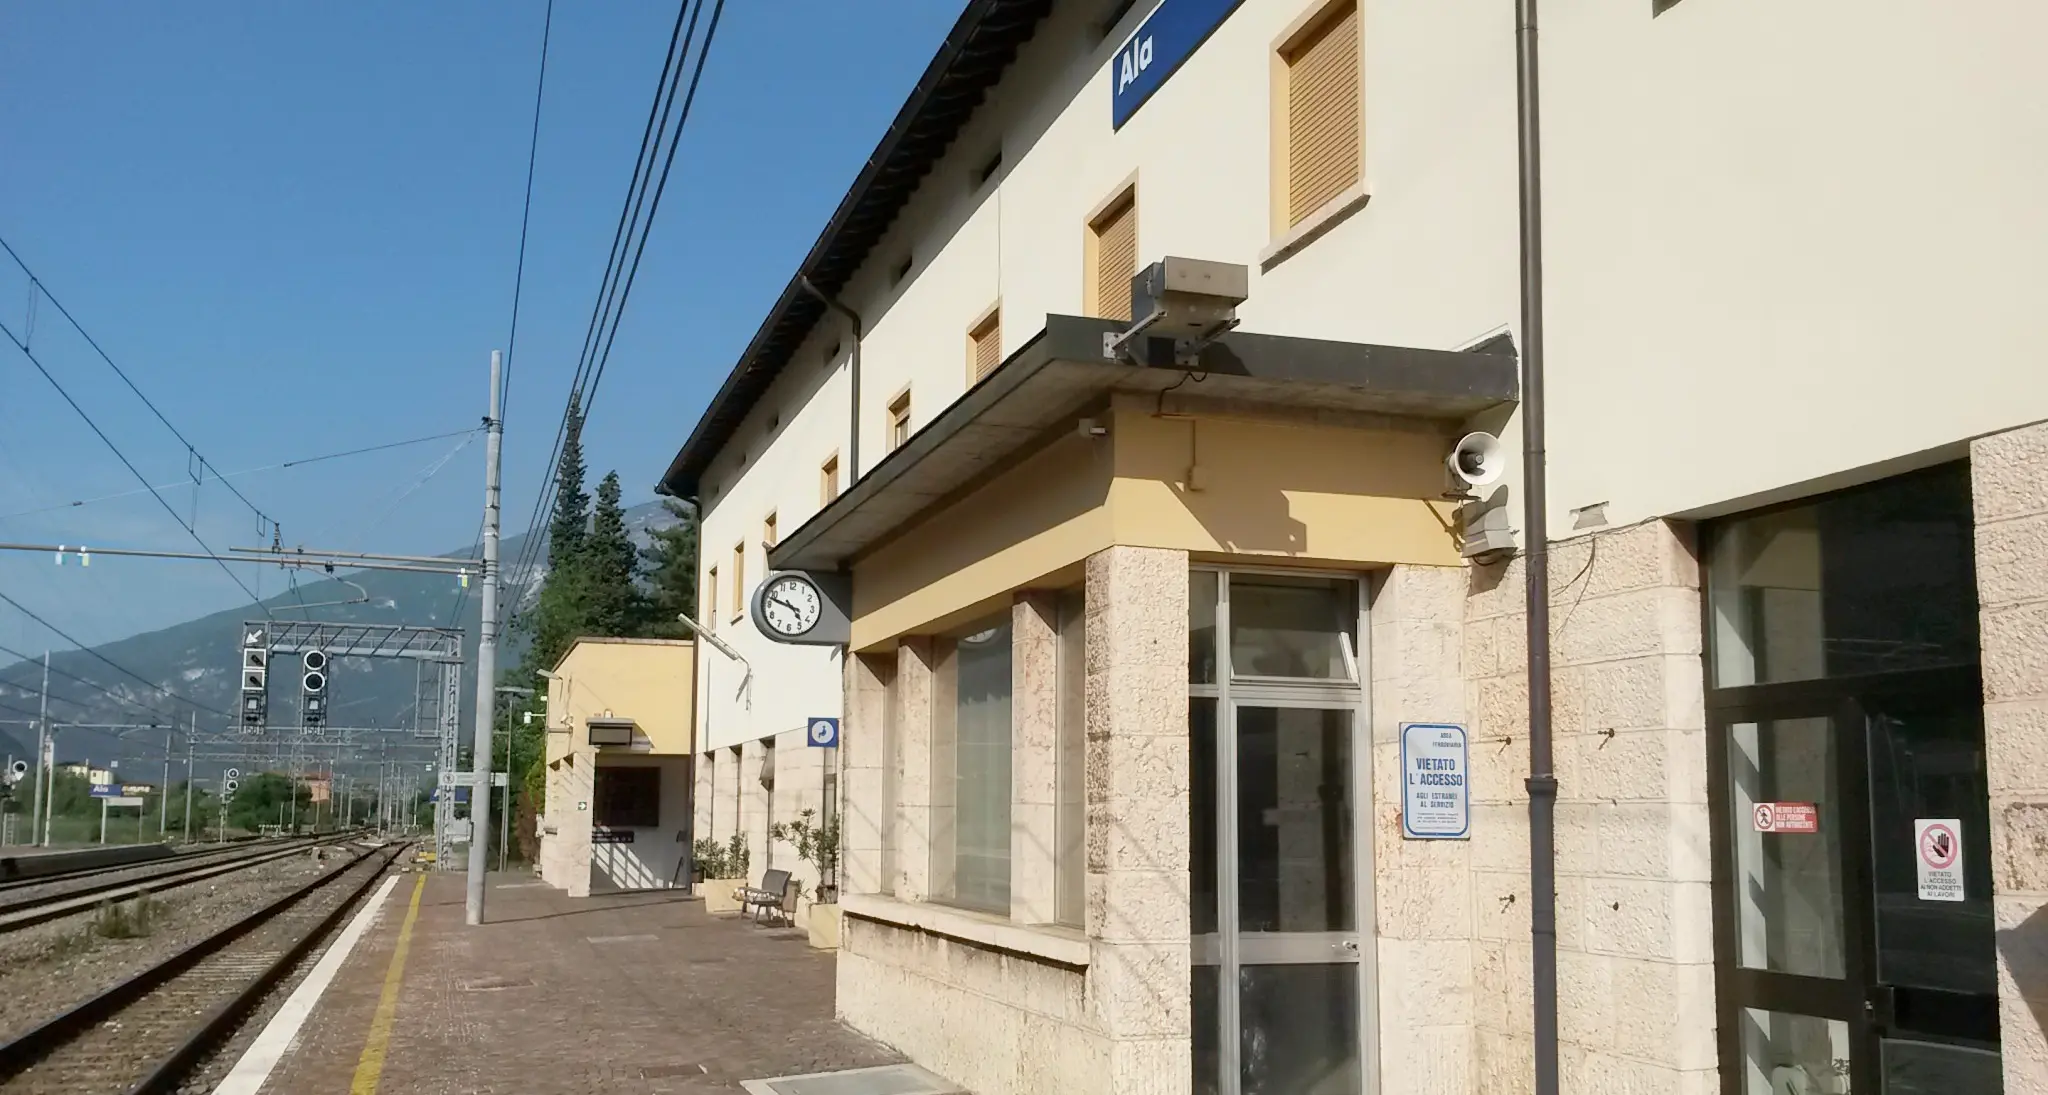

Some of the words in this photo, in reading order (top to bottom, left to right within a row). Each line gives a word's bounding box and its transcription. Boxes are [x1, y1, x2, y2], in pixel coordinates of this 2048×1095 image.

[1118, 34, 1153, 96] Ala
[780, 583, 786, 592] 11
[790, 582, 796, 590] 12
[801, 586, 805, 595] 1
[807, 594, 812, 602] 2
[810, 606, 814, 614] 3
[770, 611, 774, 620] 8
[804, 615, 810, 624] 4
[777, 619, 782, 628] 7
[786, 624, 792, 632] 6
[797, 622, 802, 630] 5
[1416, 758, 1456, 770] VIETATO
[1410, 773, 1462, 786] L'ACCESSO
[1416, 792, 1429, 800] AGLI
[1430, 801, 1455, 809] SERVIZIO
